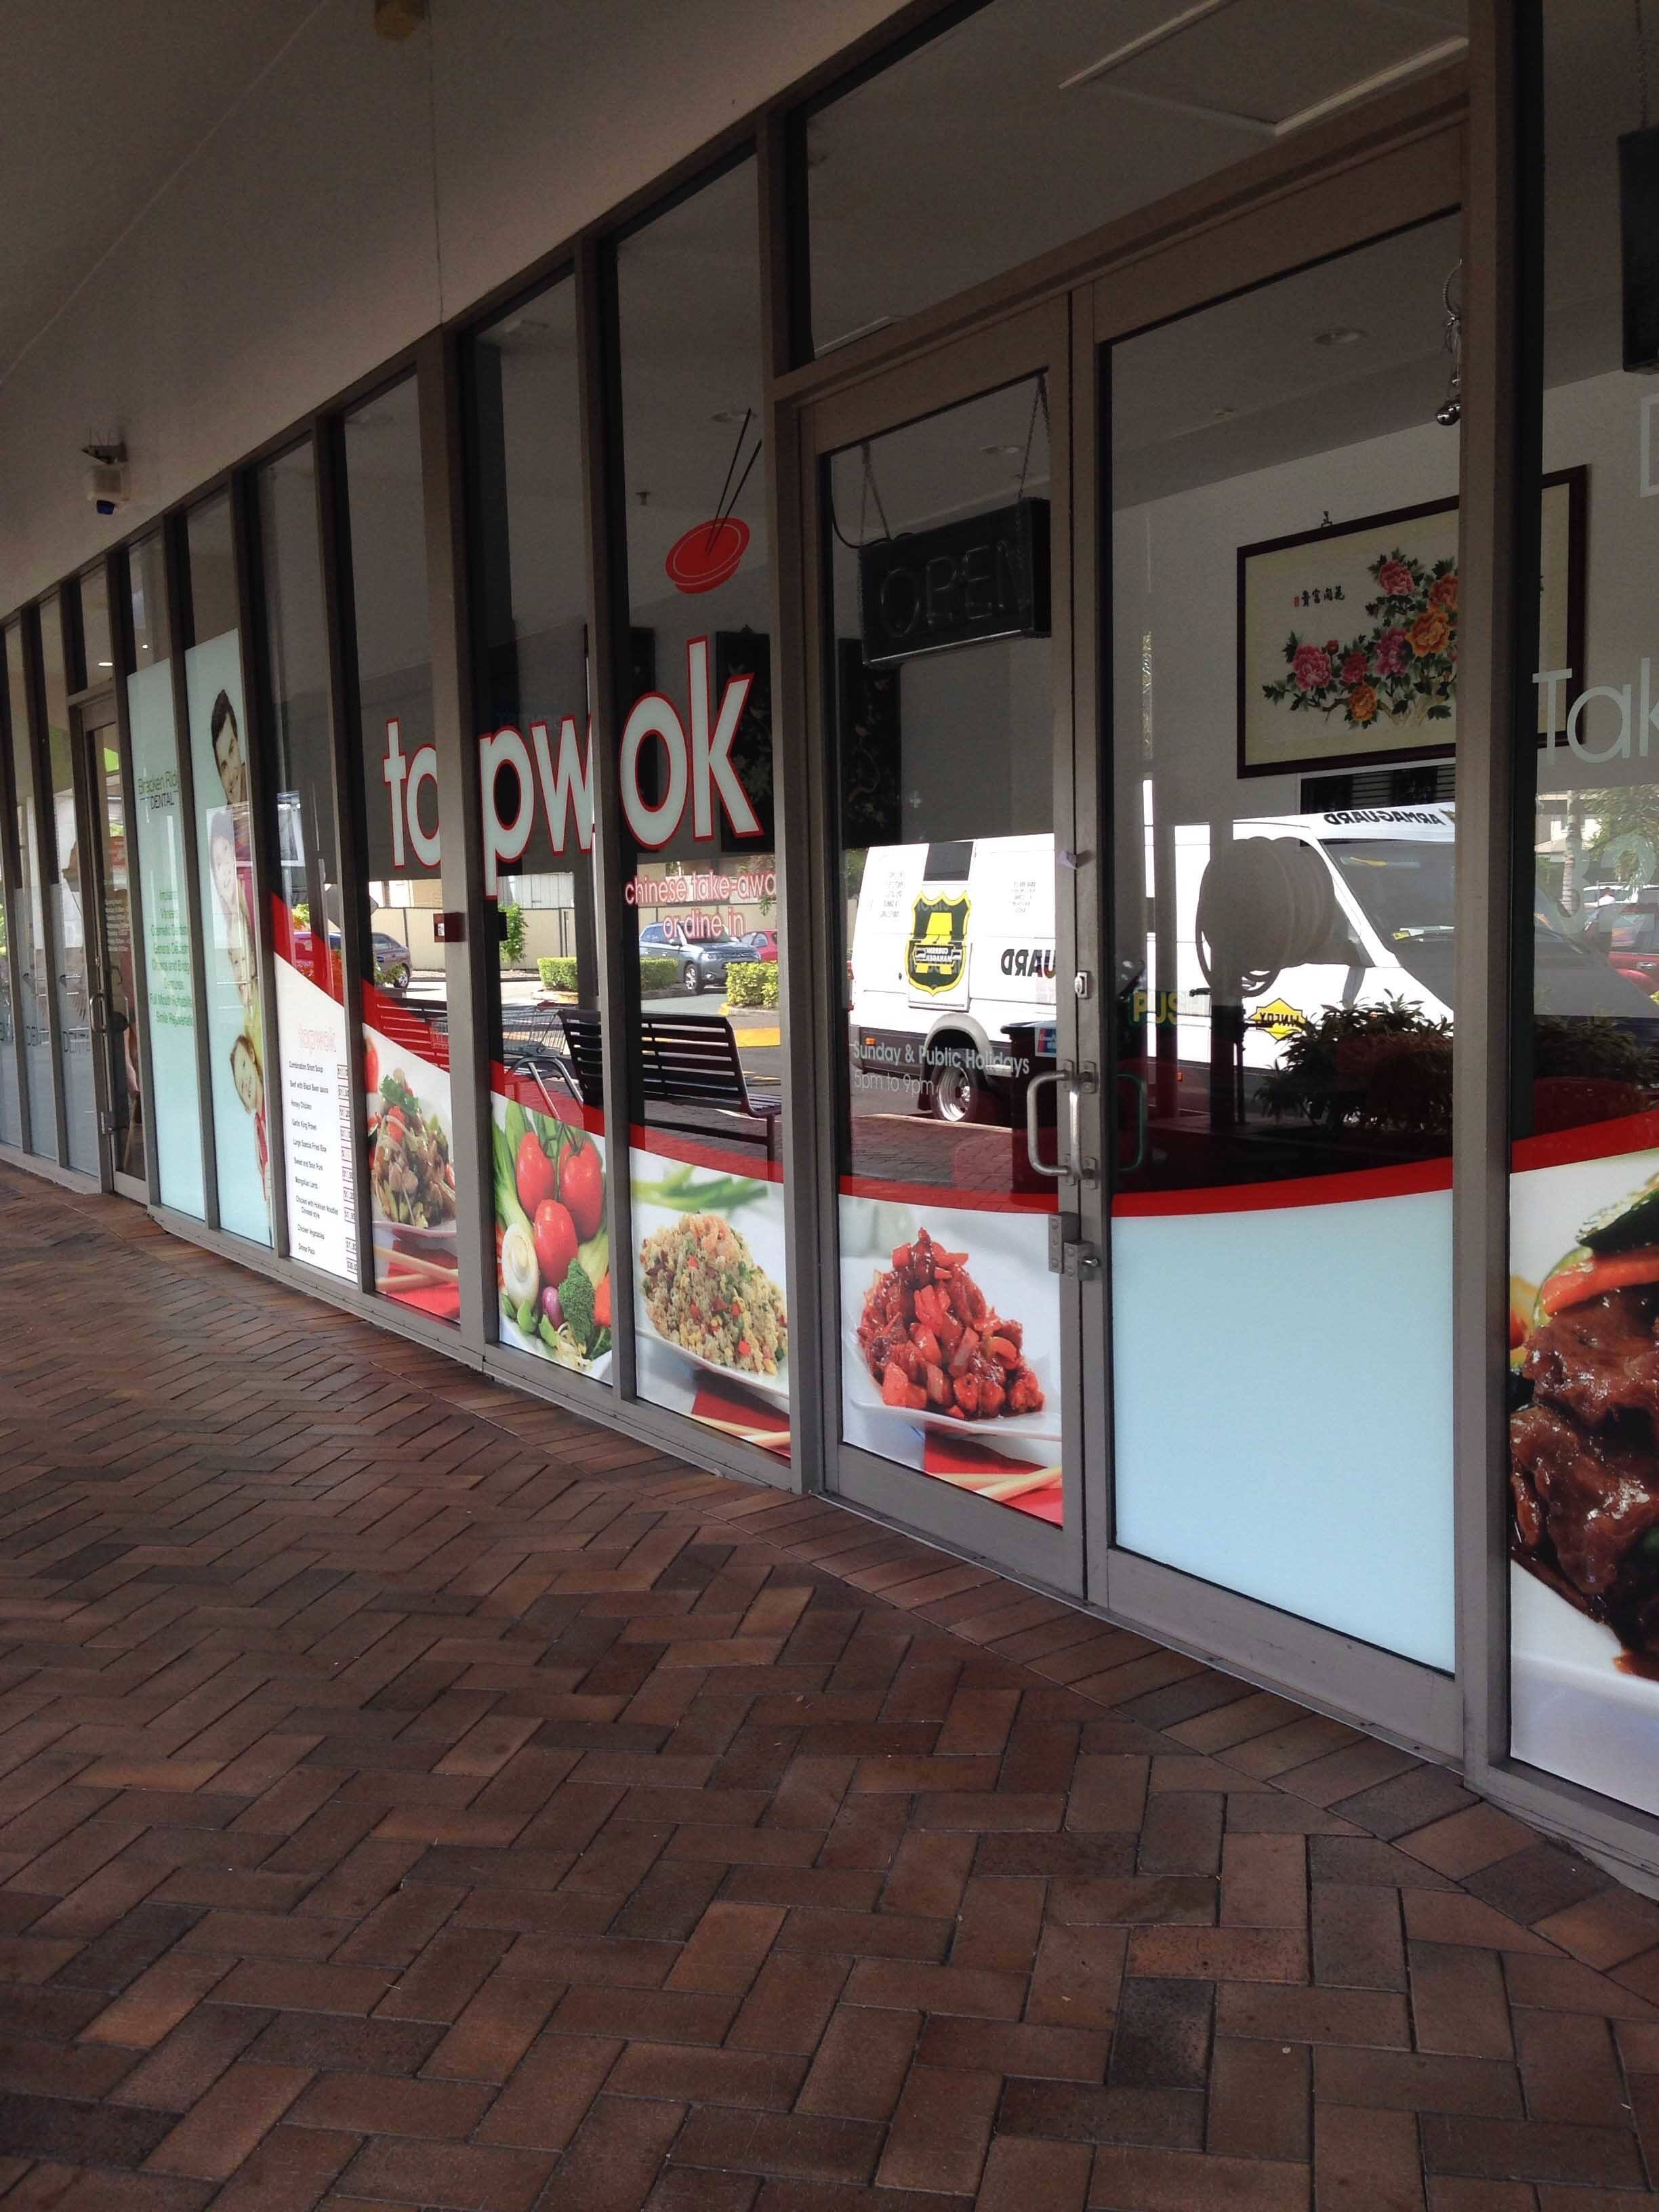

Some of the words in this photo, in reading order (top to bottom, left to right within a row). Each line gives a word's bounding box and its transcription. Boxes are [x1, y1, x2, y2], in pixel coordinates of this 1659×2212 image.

[382, 635, 764, 900] topwok
[150, 792, 175, 809] DENTAL
[625, 874, 693, 905] chinese
[663, 915, 679, 939] or
[683, 907, 724, 940] dine
[728, 905, 745, 938] in
[853, 1042, 901, 1065] Sunday
[905, 1044, 915, 1063] &
[919, 1044, 961, 1067] Public
[966, 1048, 1030, 1078] Holidays
[855, 1069, 885, 1090] 5pm
[888, 1072, 900, 1091] to
[903, 1073, 935, 1096] 9pm
